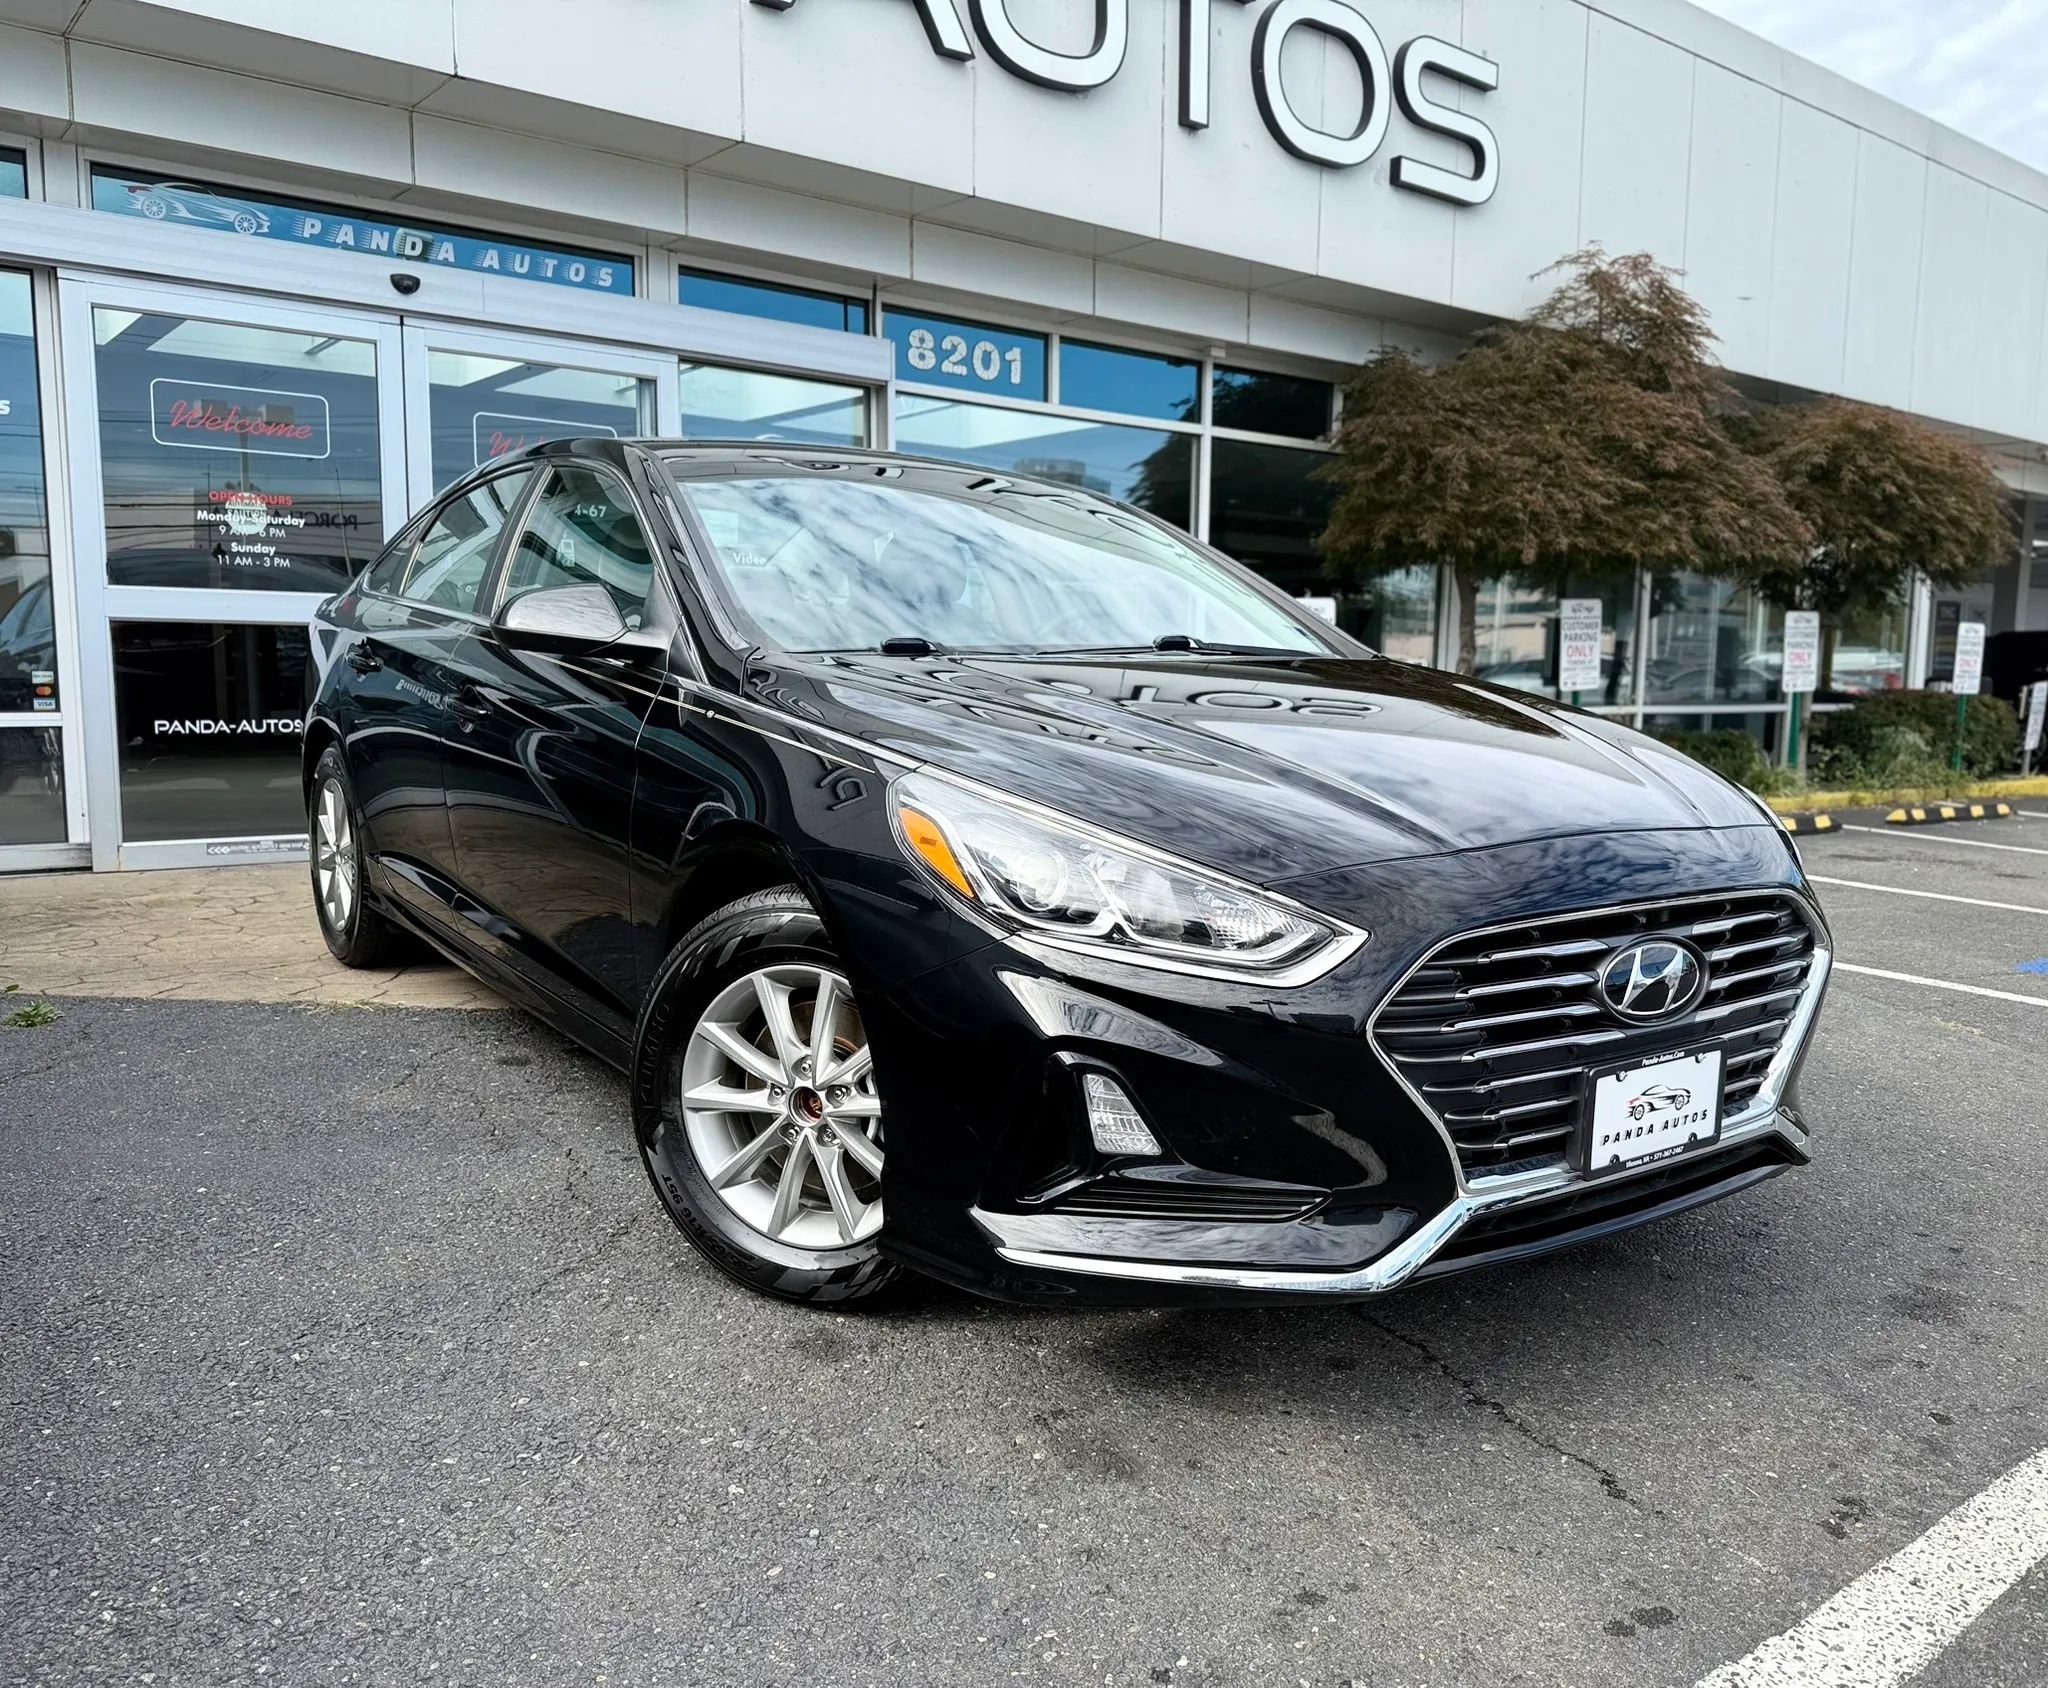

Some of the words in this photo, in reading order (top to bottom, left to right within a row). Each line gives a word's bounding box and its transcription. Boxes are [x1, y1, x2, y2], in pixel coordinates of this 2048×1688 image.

[292, 215, 455, 263] PANDA
[474, 248, 614, 288] AUTOS
[907, 328, 1022, 385] 8201
[170, 400, 313, 439] Welcome
[218, 525, 227, 536] 9
[259, 528, 267, 539] 6
[269, 528, 287, 539] PM
[218, 555, 230, 566] 11
[234, 556, 254, 567] AM
[263, 557, 271, 567] 3
[274, 557, 291, 568] PM
[231, 542, 276, 557] Sunday
[1567, 644, 1594, 658] ONLY
[1601, 1123, 1654, 1147] PANDA
[1662, 1109, 1708, 1131] AUTOS
[660, 1174, 684, 1205] 95T
